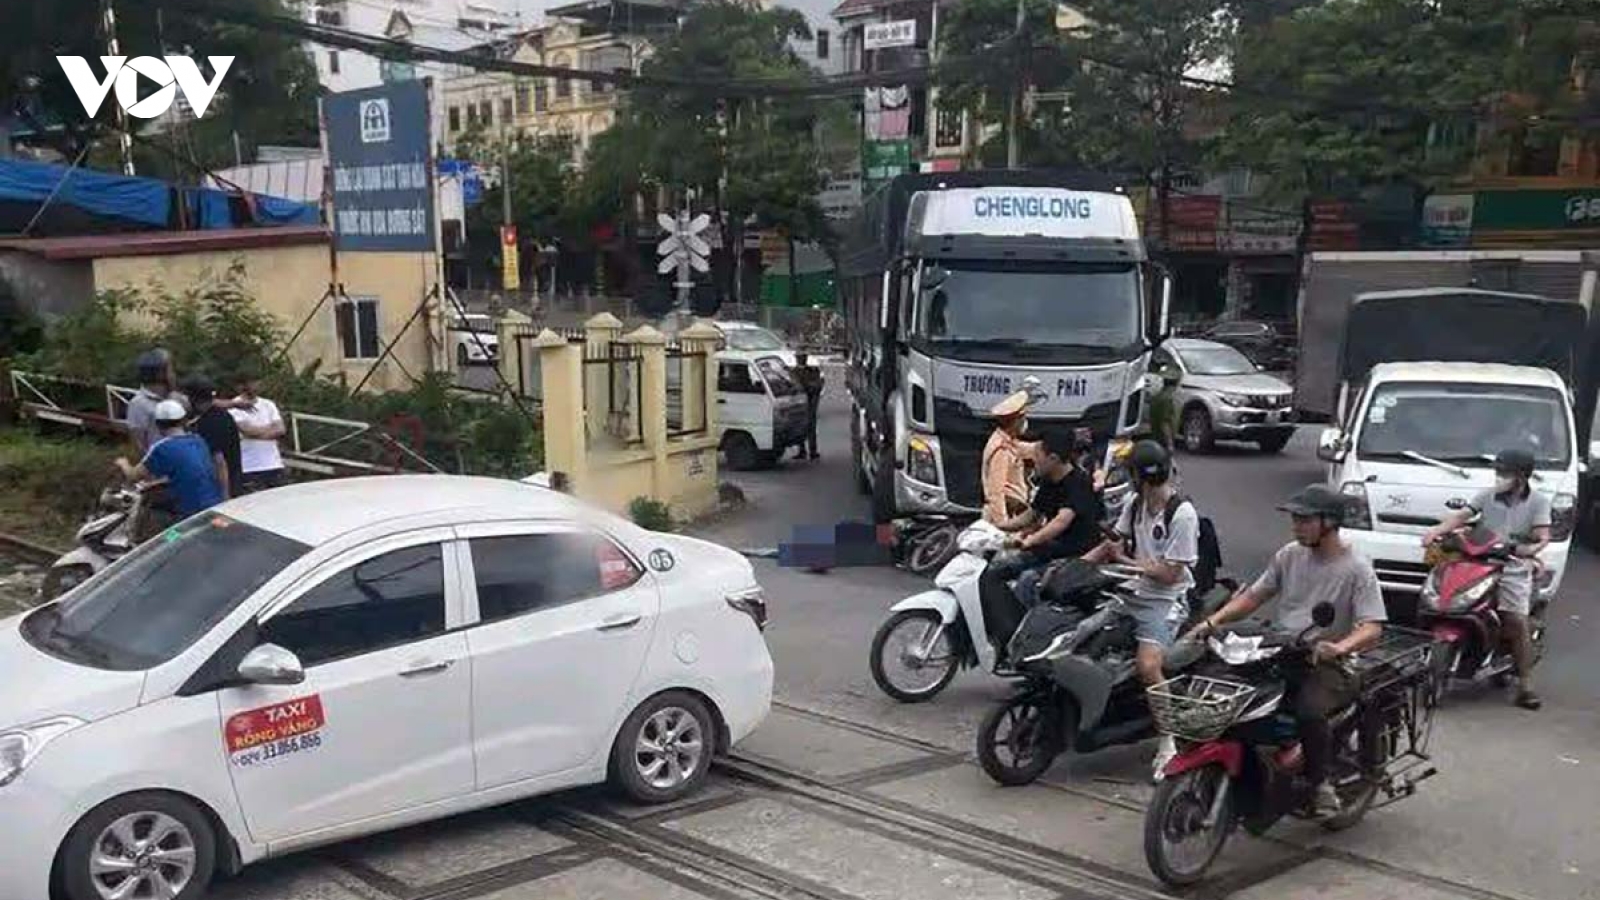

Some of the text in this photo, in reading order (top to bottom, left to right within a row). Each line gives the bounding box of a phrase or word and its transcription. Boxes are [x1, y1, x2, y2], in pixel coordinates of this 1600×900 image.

[974, 196, 1091, 219] CHENGLONG
[1056, 375, 1087, 396] PHÁT
[650, 552, 673, 569] 05
[264, 702, 306, 721] TAXI
